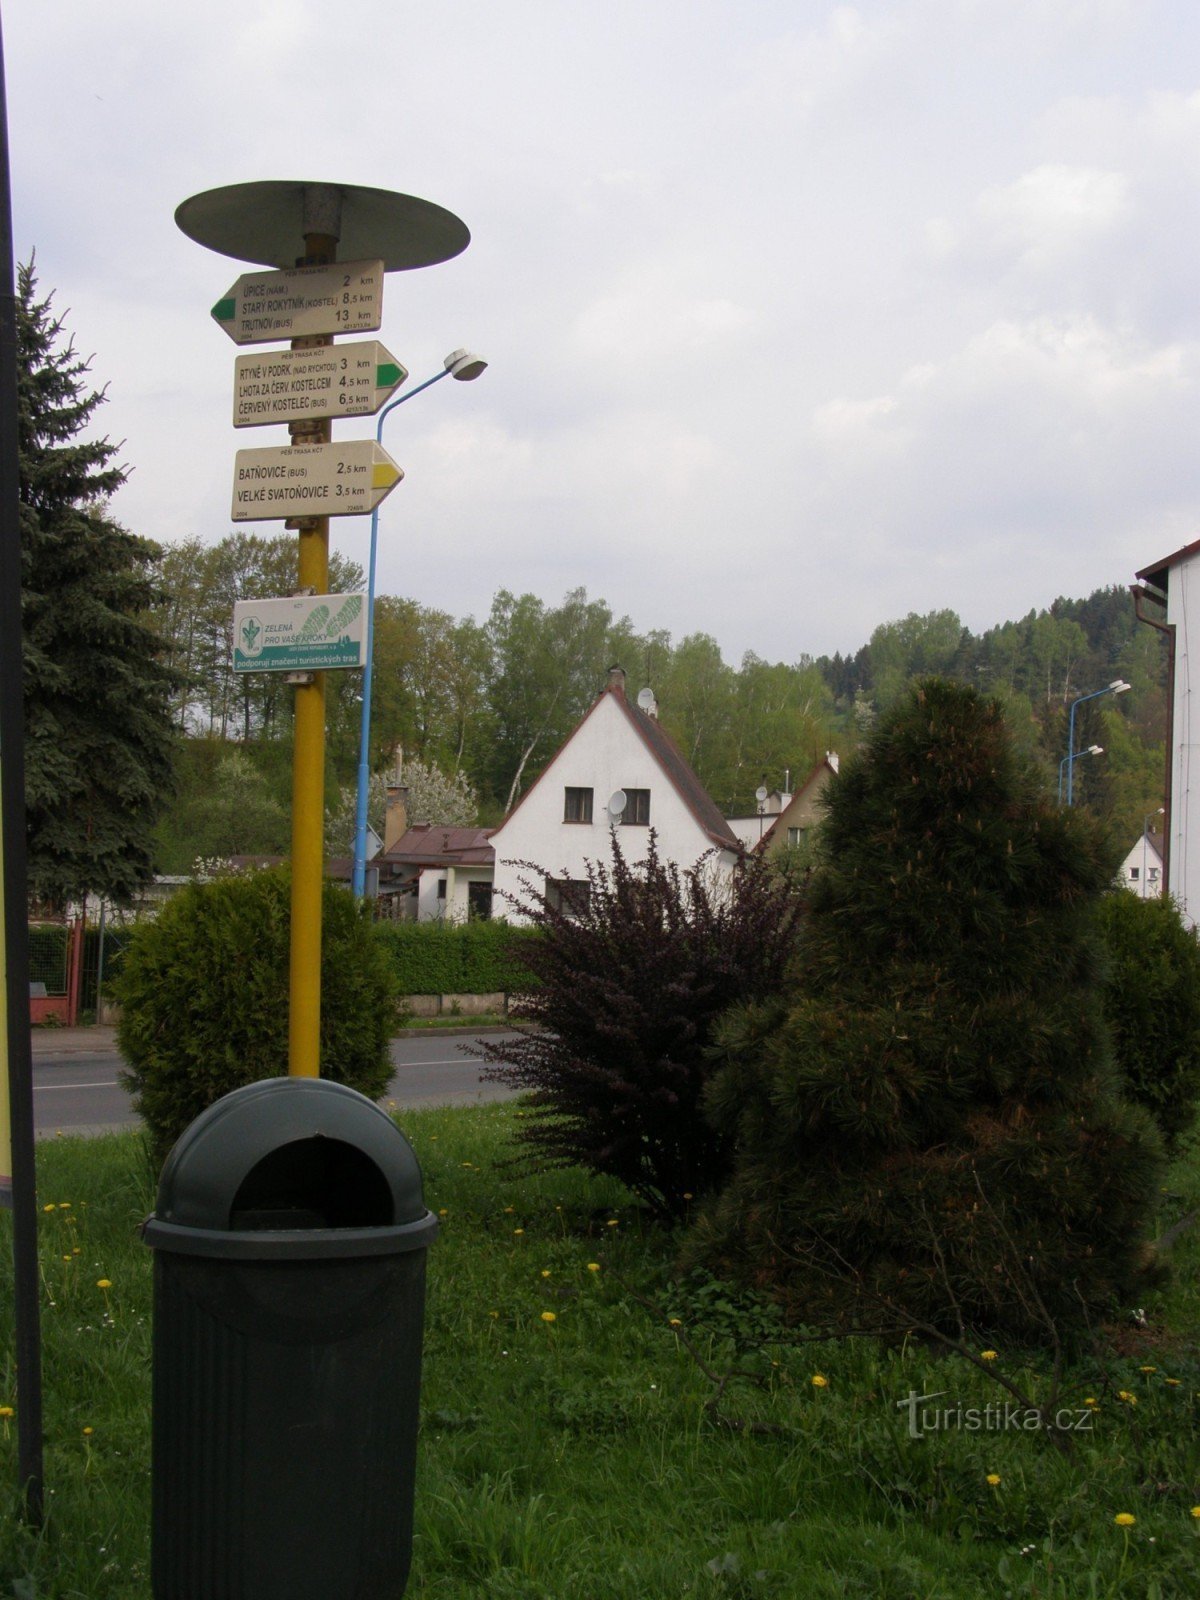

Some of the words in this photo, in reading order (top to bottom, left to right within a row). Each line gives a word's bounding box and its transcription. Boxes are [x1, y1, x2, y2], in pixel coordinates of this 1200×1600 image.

[343, 275, 351, 287] 2
[360, 277, 373, 285] km
[242, 299, 267, 315] STARÝ
[305, 297, 339, 309] (KOSTEL)
[342, 292, 358, 304] 8,5
[241, 317, 273, 331] TRUTNOV
[274, 319, 293, 329] (BUS)
[335, 309, 349, 321] 13
[262, 366, 268, 378] V
[292, 365, 307, 377] (NAD
[308, 362, 337, 374] RYCHTOU)
[340, 358, 348, 370] 3
[356, 360, 370, 368] km
[239, 384, 261, 397] LHOTA
[261, 383, 270, 395] ZA
[271, 380, 290, 394] ČERV.
[291, 377, 331, 392] KOSTELCEM
[339, 375, 355, 387] 4,5
[356, 377, 370, 386] km
[239, 397, 272, 414] ČERVENÝ
[272, 396, 310, 411] KOSTELEC
[310, 399, 328, 409] (BUS)
[339, 393, 354, 405] 6,5
[239, 465, 287, 480] BATŇOVICE
[287, 468, 308, 479] (BUS)
[337, 462, 352, 475] 2,5
[353, 465, 367, 473] km
[238, 487, 266, 502] VELKÉ
[267, 484, 329, 501] SVATOŇOVICE
[335, 484, 350, 497] 3,5
[352, 487, 365, 495] km
[264, 621, 294, 633] ZELENÁ
[264, 635, 281, 644] PRO
[301, 632, 328, 643] KROKY
[299, 654, 341, 664] turistických
